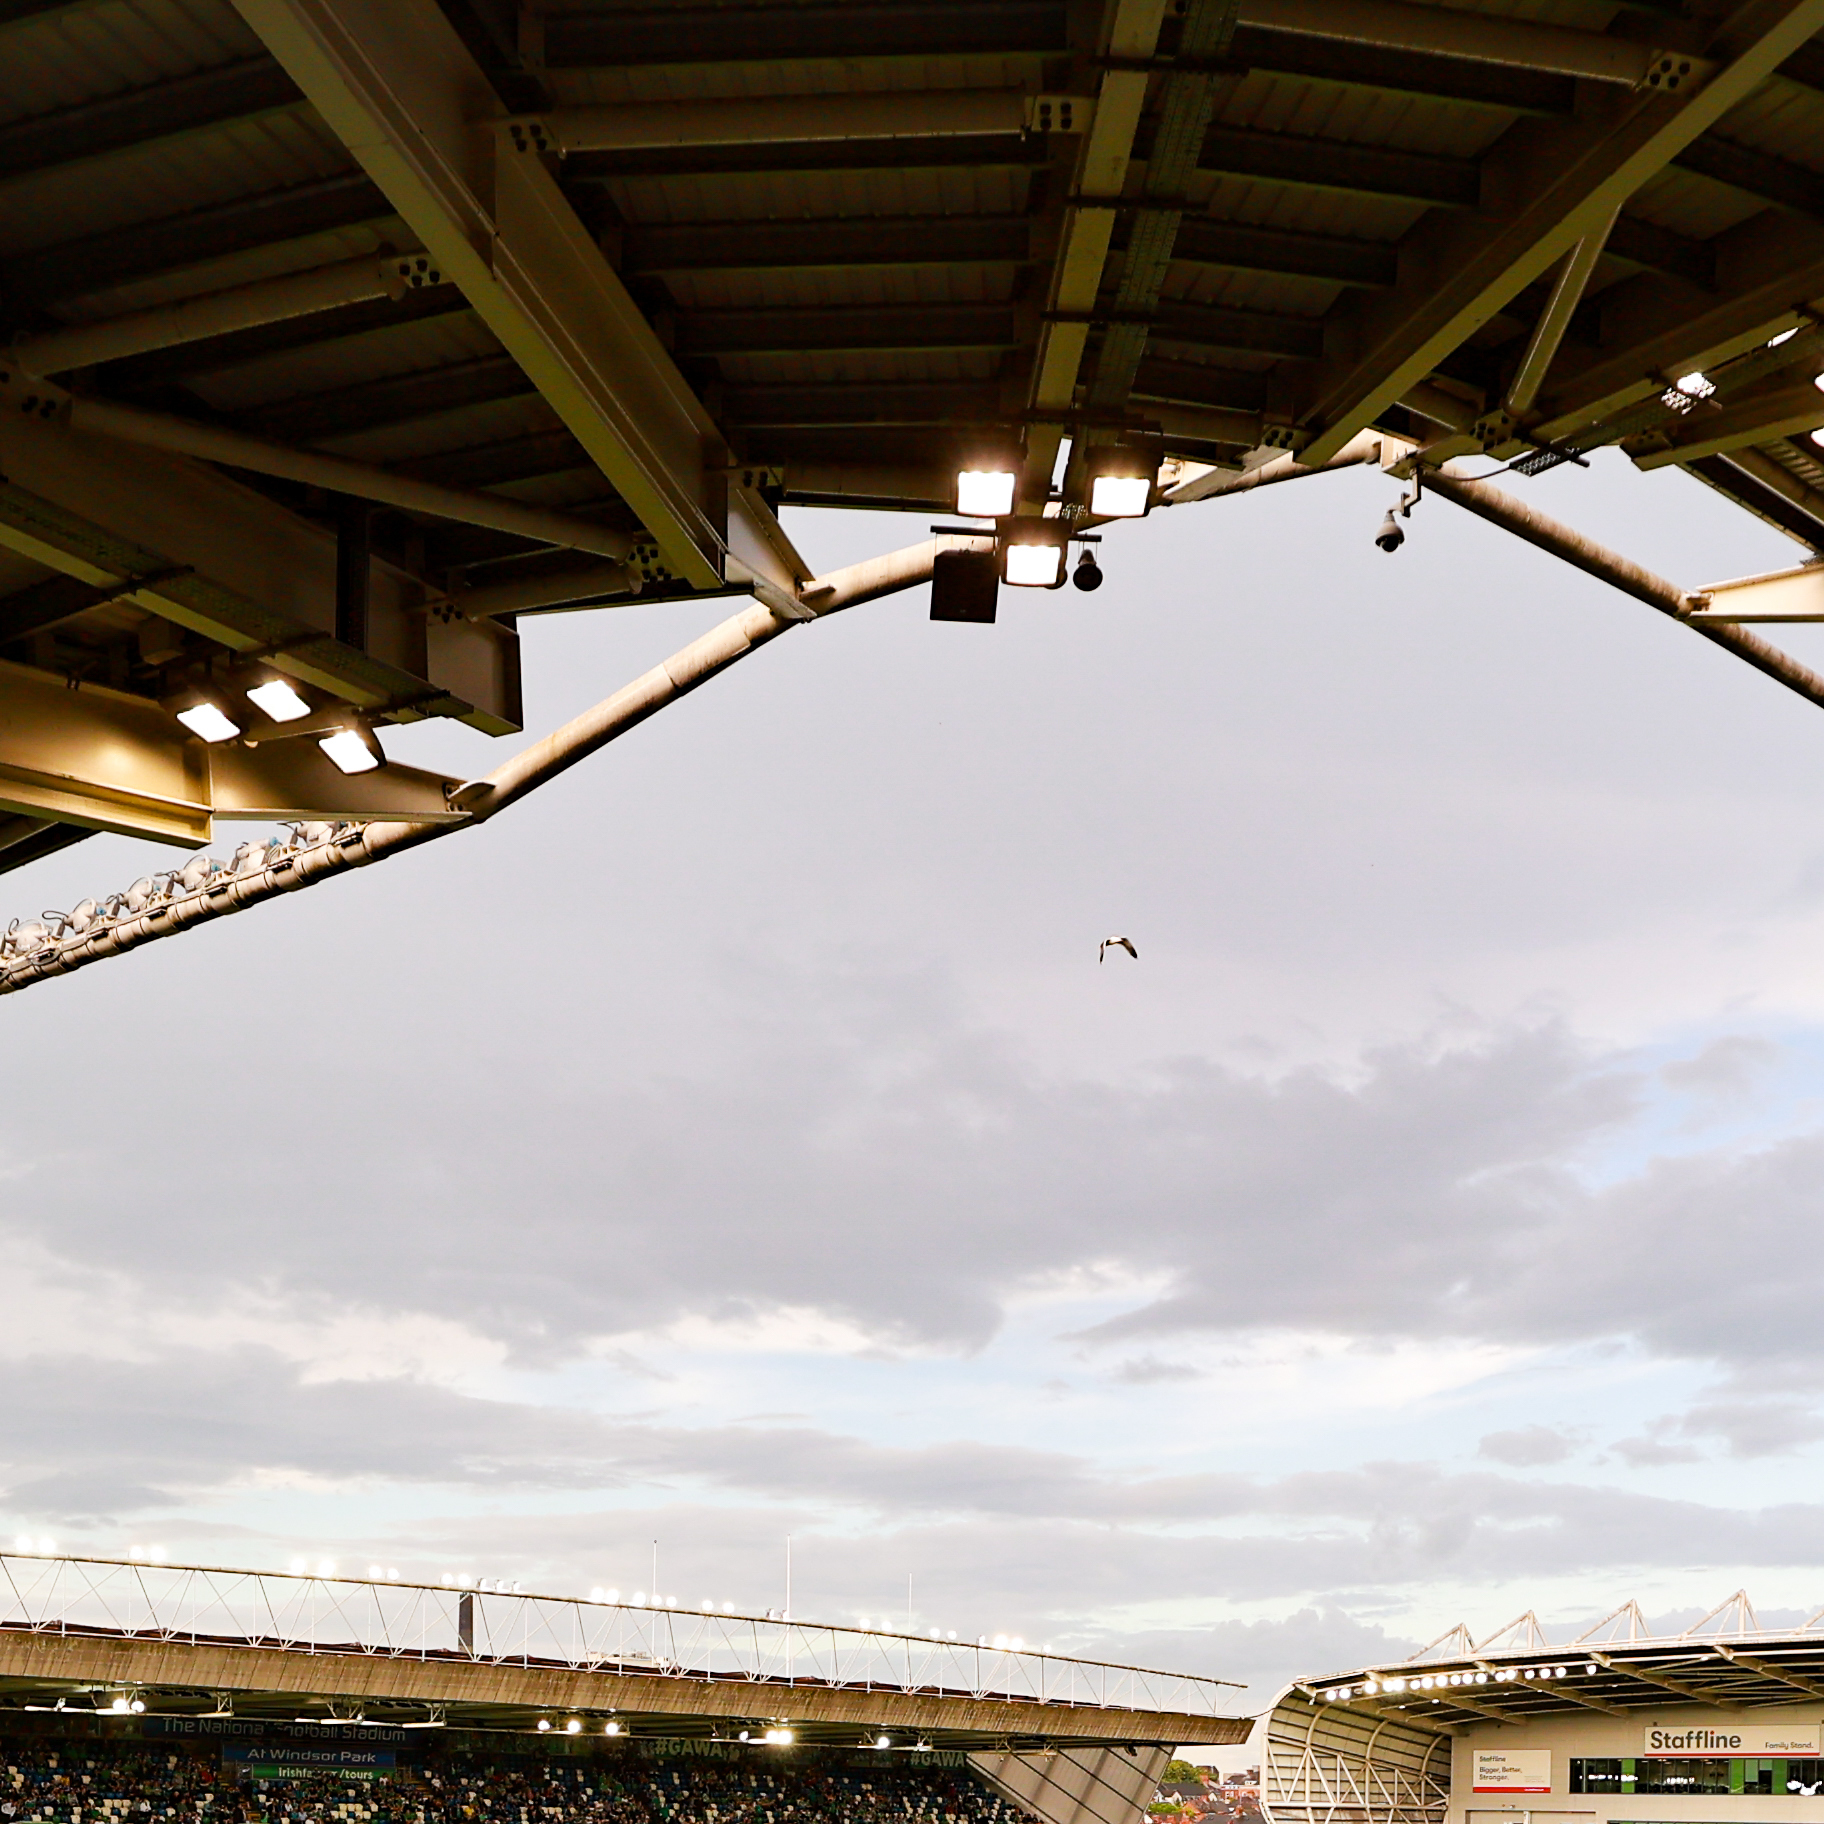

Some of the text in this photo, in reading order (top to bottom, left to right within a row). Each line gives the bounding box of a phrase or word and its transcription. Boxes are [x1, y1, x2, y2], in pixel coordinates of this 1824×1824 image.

[163, 1718, 195, 1734] The
[342, 1725, 406, 1742] Stadium
[1650, 1730, 1742, 1749] Staffline
[248, 1748, 376, 1763] At Windsor Park
